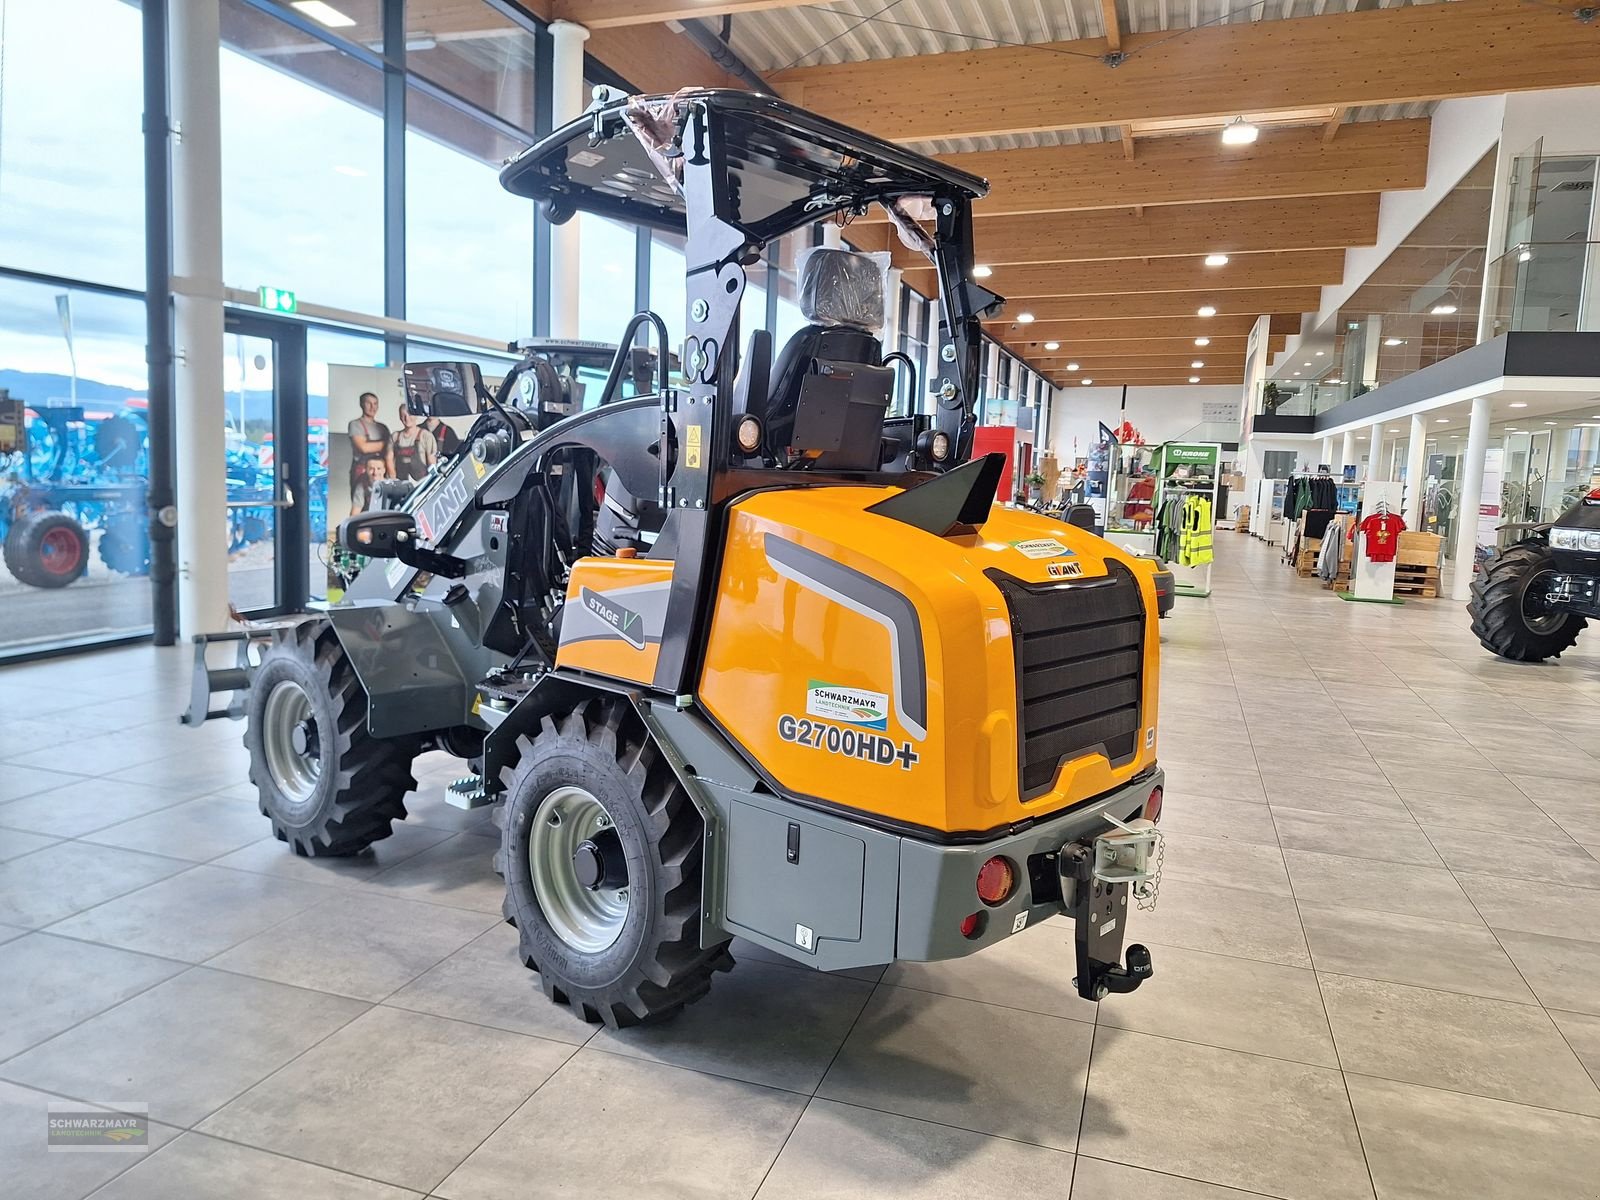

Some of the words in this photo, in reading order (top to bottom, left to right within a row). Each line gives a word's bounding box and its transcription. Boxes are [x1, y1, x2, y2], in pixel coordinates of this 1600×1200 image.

[413, 468, 468, 541] IANT
[1047, 562, 1083, 577] GIANT
[588, 597, 619, 626] STAGE
[814, 689, 877, 709] SCHWARZMAYR
[815, 699, 851, 711] LANDTECHNIK
[777, 714, 919, 771] G2700HD+
